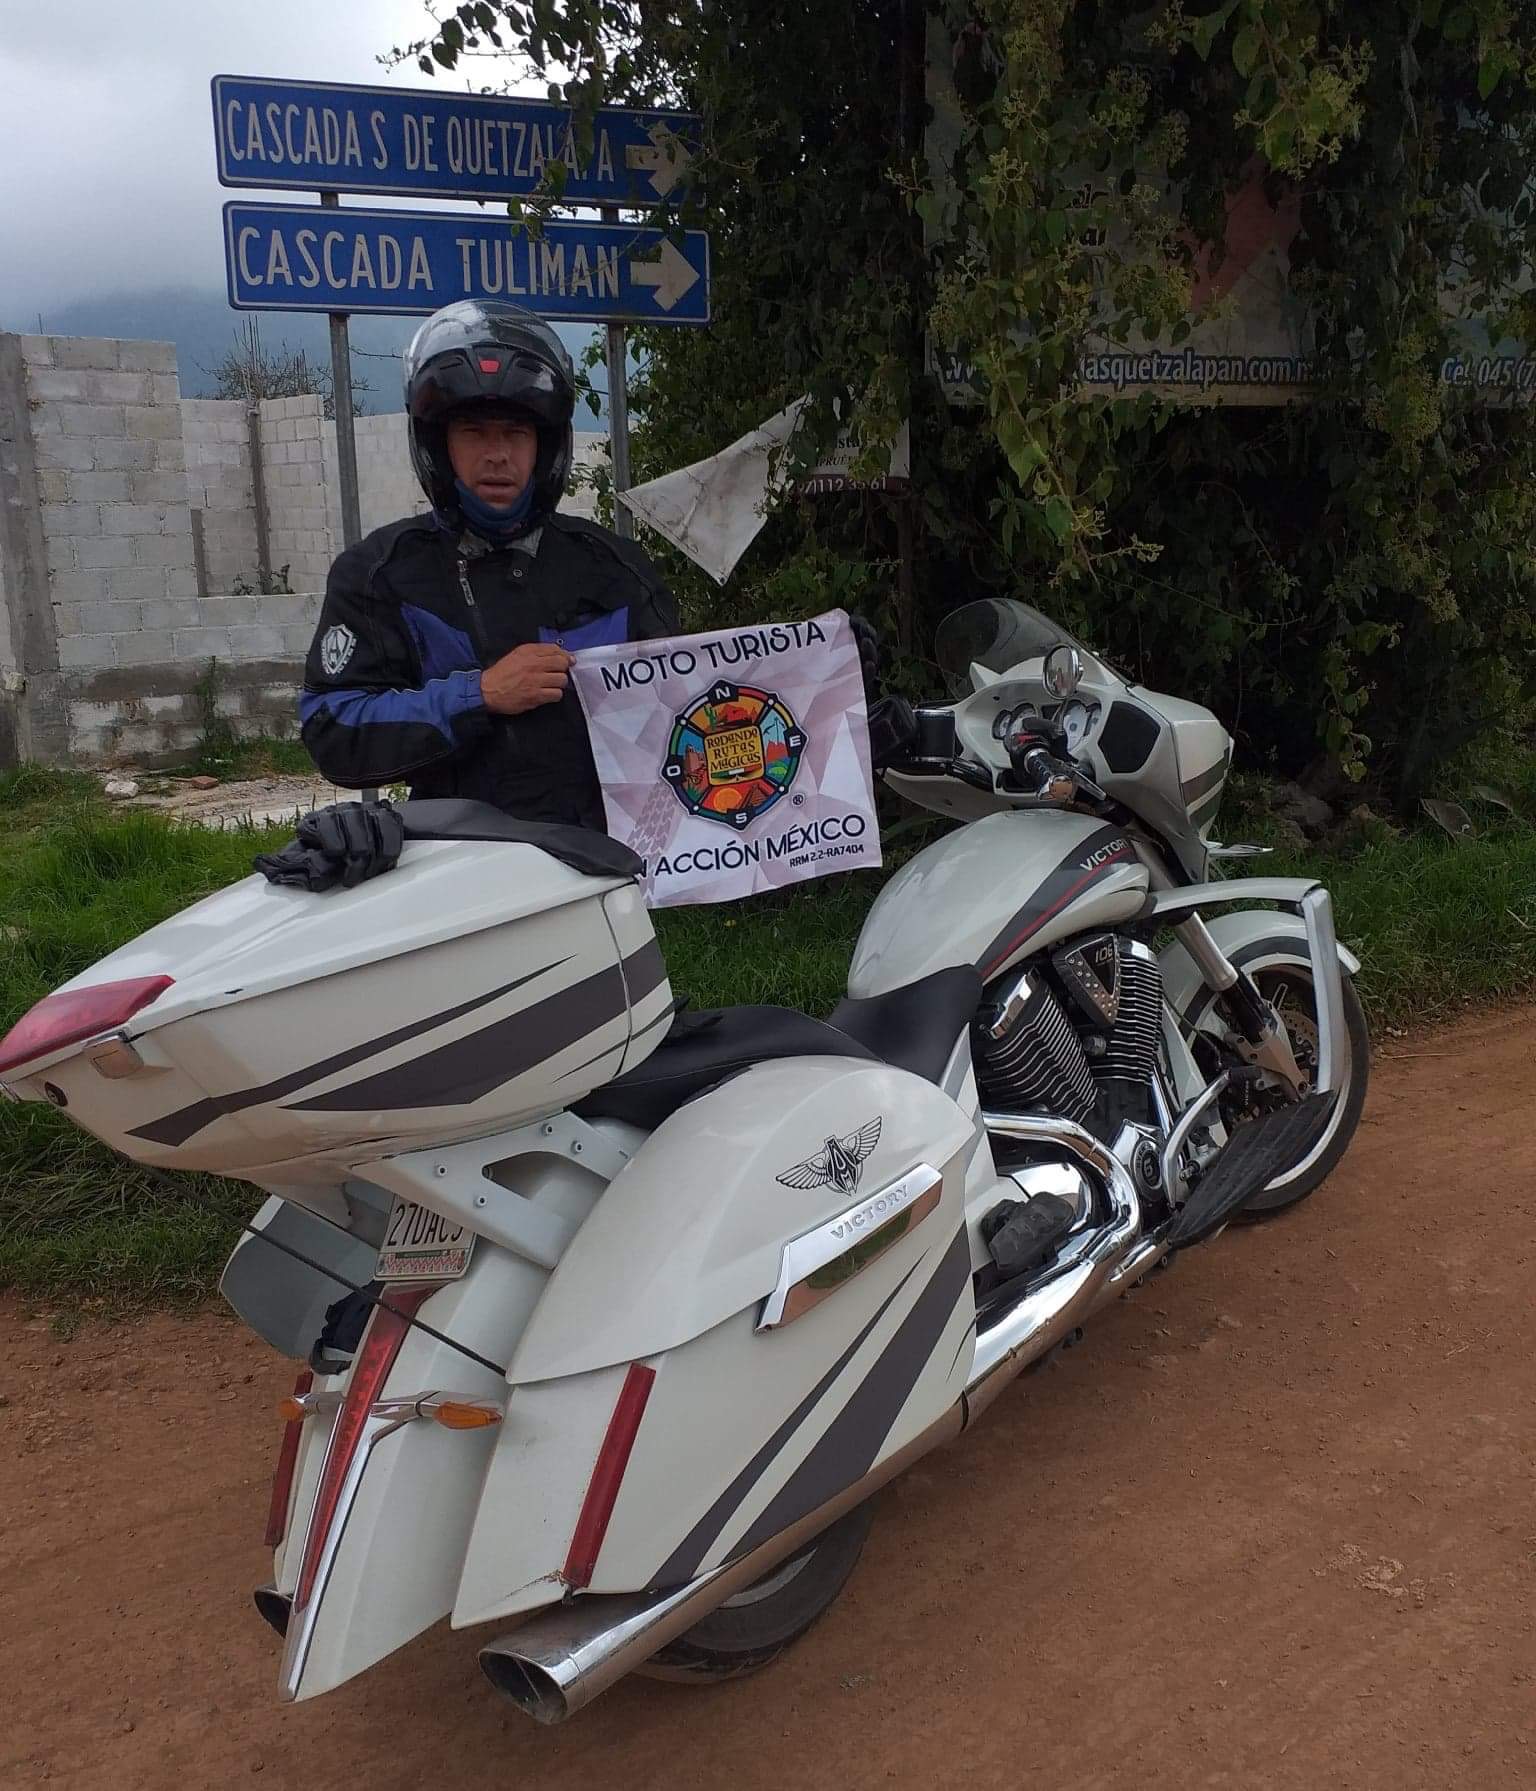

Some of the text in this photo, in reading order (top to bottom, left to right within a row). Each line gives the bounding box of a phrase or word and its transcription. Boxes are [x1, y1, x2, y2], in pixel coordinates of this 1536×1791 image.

[403, 114, 439, 172] DE
[446, 115, 615, 182] QUETZALAA
[238, 225, 620, 298] CASCADA TULIMAN
[600, 621, 826, 692] MOTO TURISTA
[715, 686, 731, 700] N
[789, 735, 802, 747] E
[655, 840, 760, 876] ACCIÓN
[766, 814, 866, 860] MÉXICO
[735, 812, 748, 824] S
[789, 853, 810, 868] RRM
[830, 1184, 911, 1240] VICTORY
